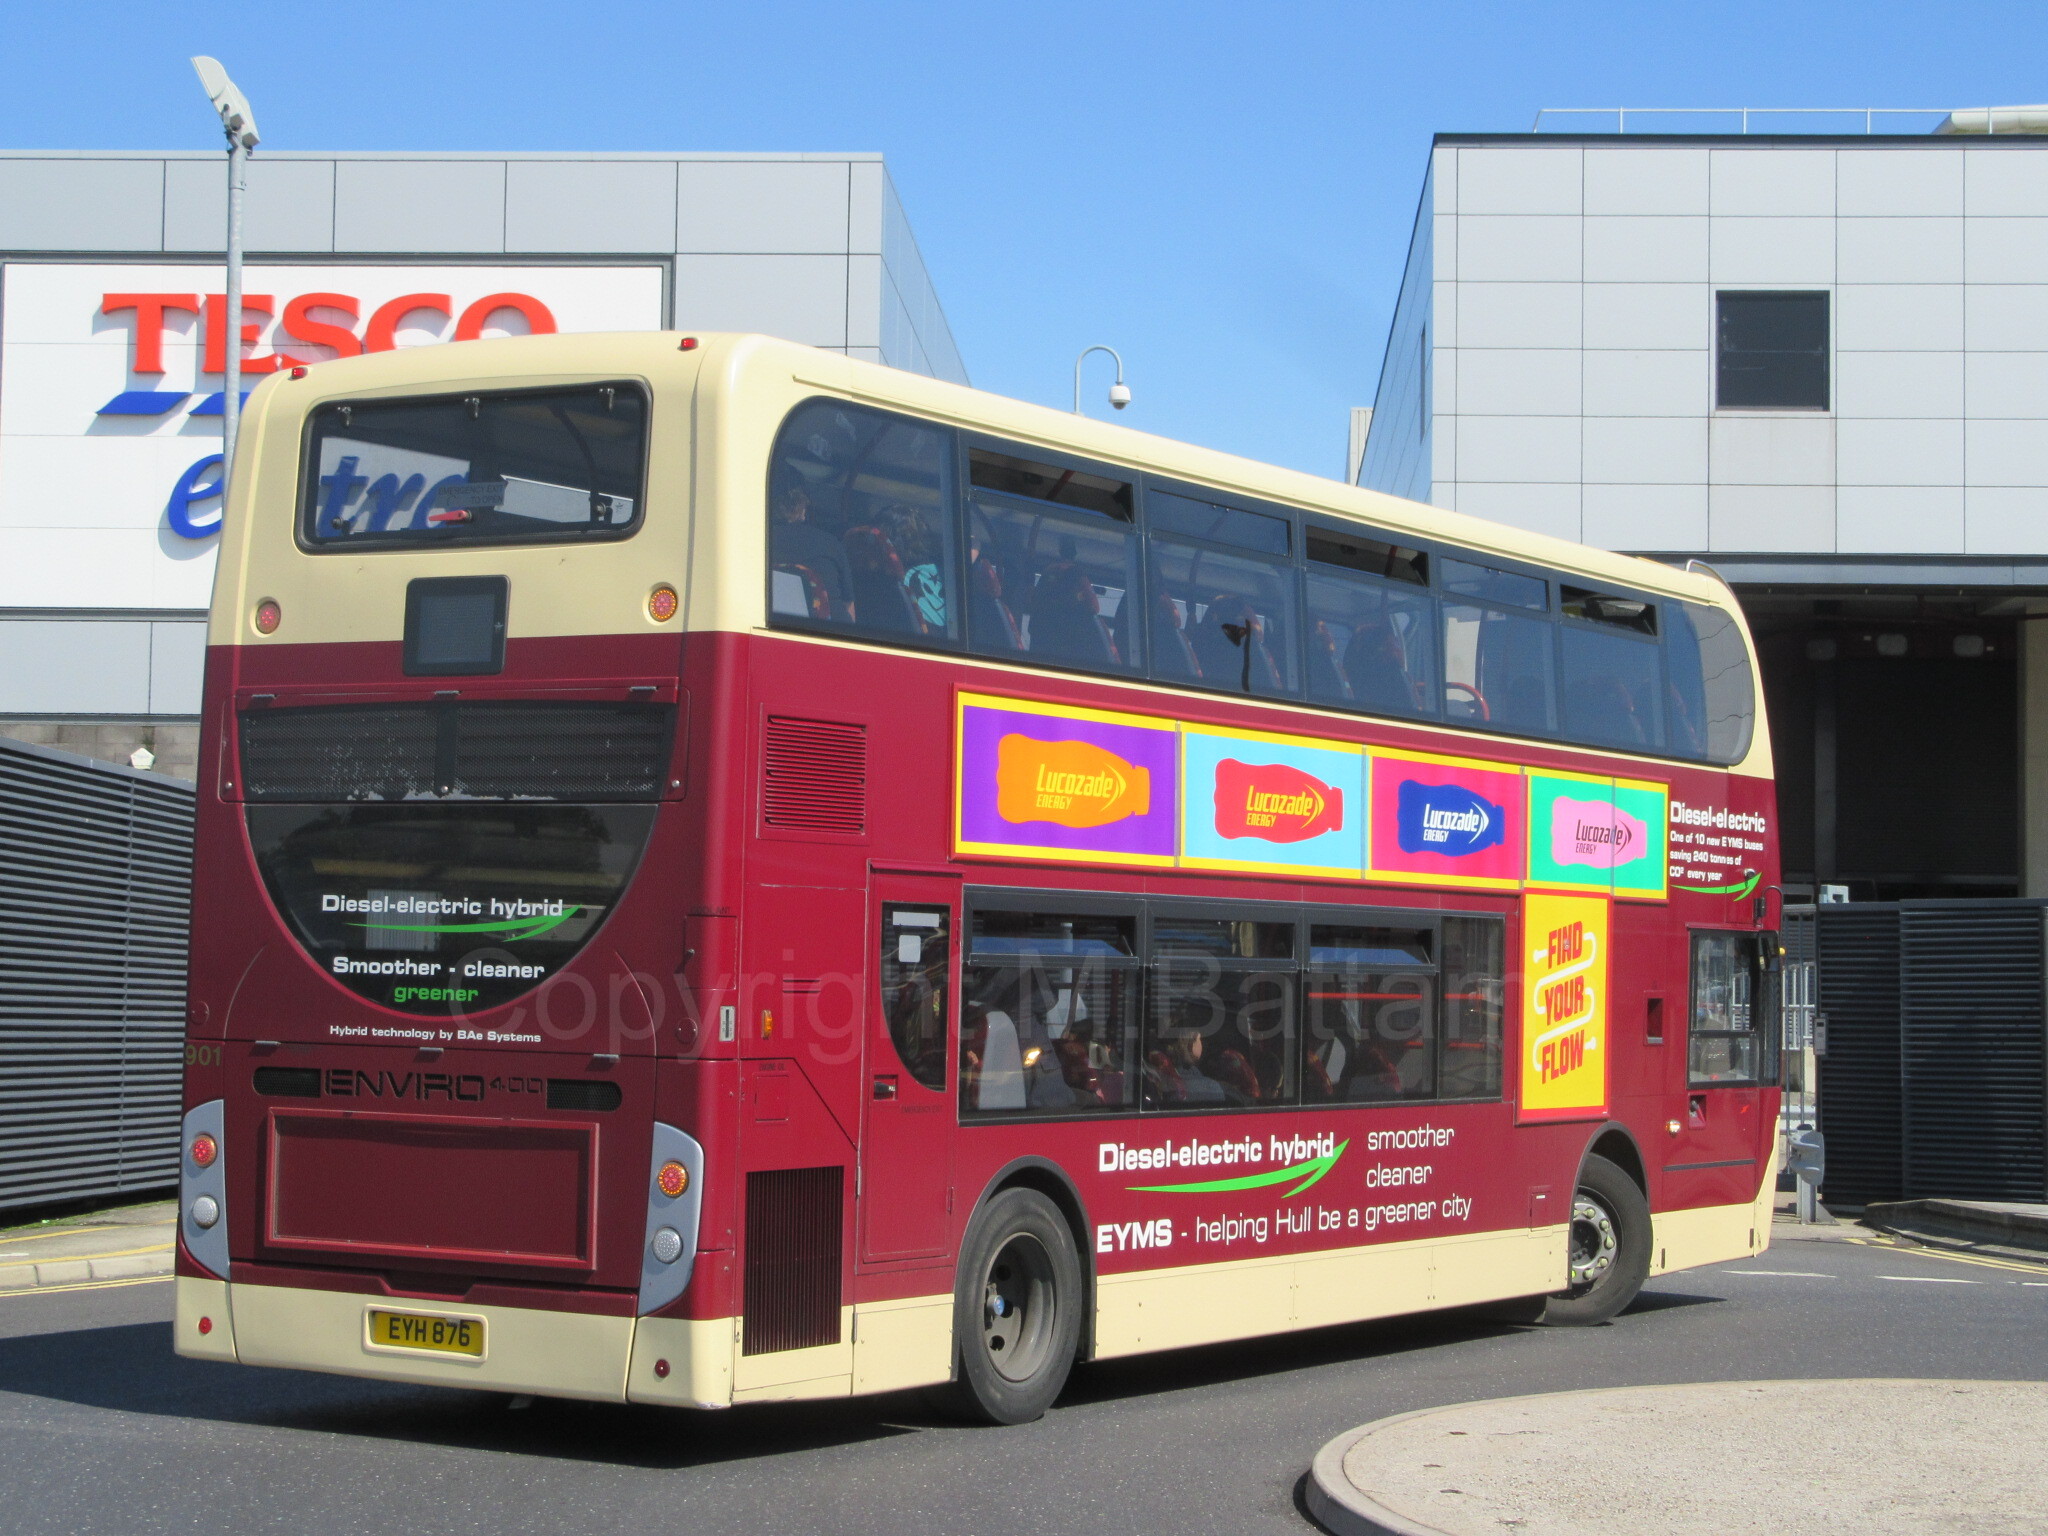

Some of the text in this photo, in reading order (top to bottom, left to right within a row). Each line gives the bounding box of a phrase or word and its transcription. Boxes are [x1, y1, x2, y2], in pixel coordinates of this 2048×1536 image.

[1036, 763, 1114, 798] Lucozade
[1036, 794, 1073, 810] ENERGY
[1246, 785, 1313, 816] Lucozade
[1246, 813, 1277, 828] ENERGY
[1423, 803, 1480, 832] Lucozade
[1670, 800, 1766, 833] Diesel-electric
[1423, 829, 1450, 843] ENERGY
[1575, 819, 1624, 846] Lucozade
[1670, 830, 1684, 842] One
[1686, 832, 1693, 844] of
[1695, 833, 1705, 845] 10
[1706, 836, 1720, 847] new
[1744, 839, 1764, 851] buses
[1575, 842, 1597, 855] ENERGY
[1669, 849, 1742, 866] saving 240 tonnes of
[1687, 870, 1706, 882] every
[1707, 871, 1723, 882] year
[322, 894, 564, 921] Diesel-electric hybrid
[1547, 920, 1583, 970] FIND
[333, 956, 441, 976] Smoother
[464, 960, 545, 979] cleaner
[394, 986, 479, 1003] greener
[1544, 975, 1585, 1026] YOUR
[329, 1024, 542, 1043] Hybrid technology by BAe Systems
[185, 1045, 222, 1067] 901
[1541, 1029, 1585, 1085] FLOW
[1367, 1123, 1455, 1151] smoother
[1099, 1132, 1335, 1172] Diesel-electric hybrid
[1366, 1163, 1433, 1188] cleaner
[1096, 1219, 1173, 1253] EYMS
[1195, 1213, 1268, 1245] helping
[1276, 1207, 1311, 1236] Hull
[1318, 1206, 1341, 1231] be
[1347, 1209, 1359, 1228] a
[1365, 1203, 1436, 1231] greener
[1442, 1192, 1472, 1221] city
[389, 1316, 471, 1347] EYH 876
